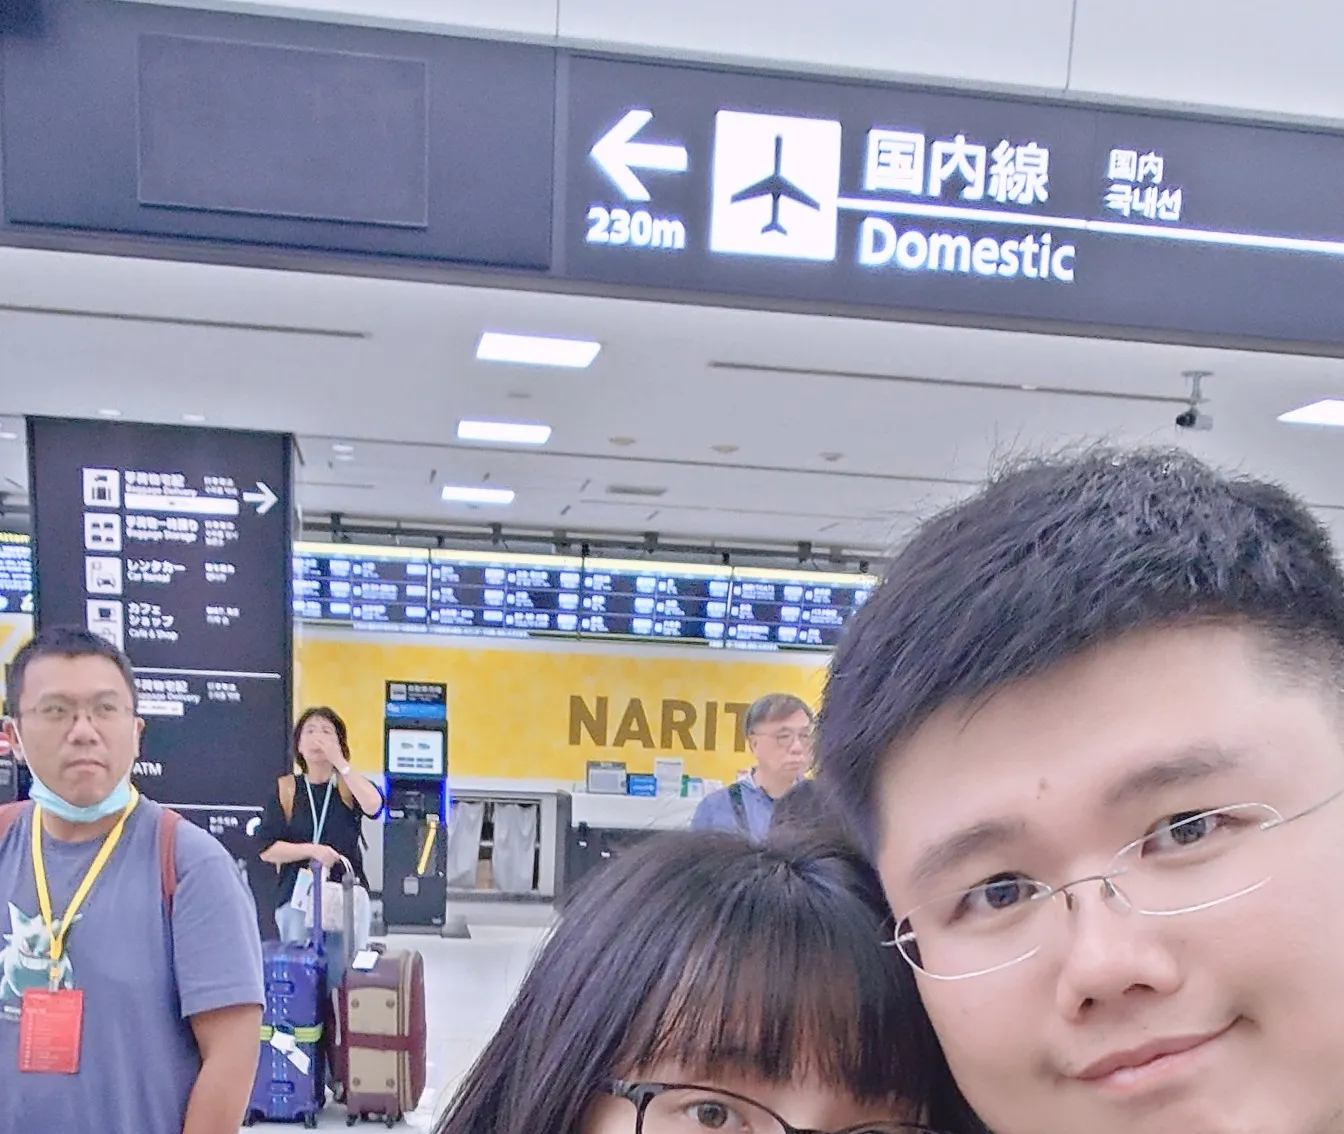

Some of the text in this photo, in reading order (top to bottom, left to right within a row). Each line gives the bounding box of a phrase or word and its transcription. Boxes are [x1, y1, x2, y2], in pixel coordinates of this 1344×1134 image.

[865, 128, 1050, 205] 国内線
[1108, 149, 1164, 184] 国内
[1104, 183, 1183, 222] 국내선
[585, 207, 686, 250] 230m
[861, 217, 1076, 282] Domestic
[567, 694, 750, 753] NARIT
[133, 761, 163, 776] ATM
